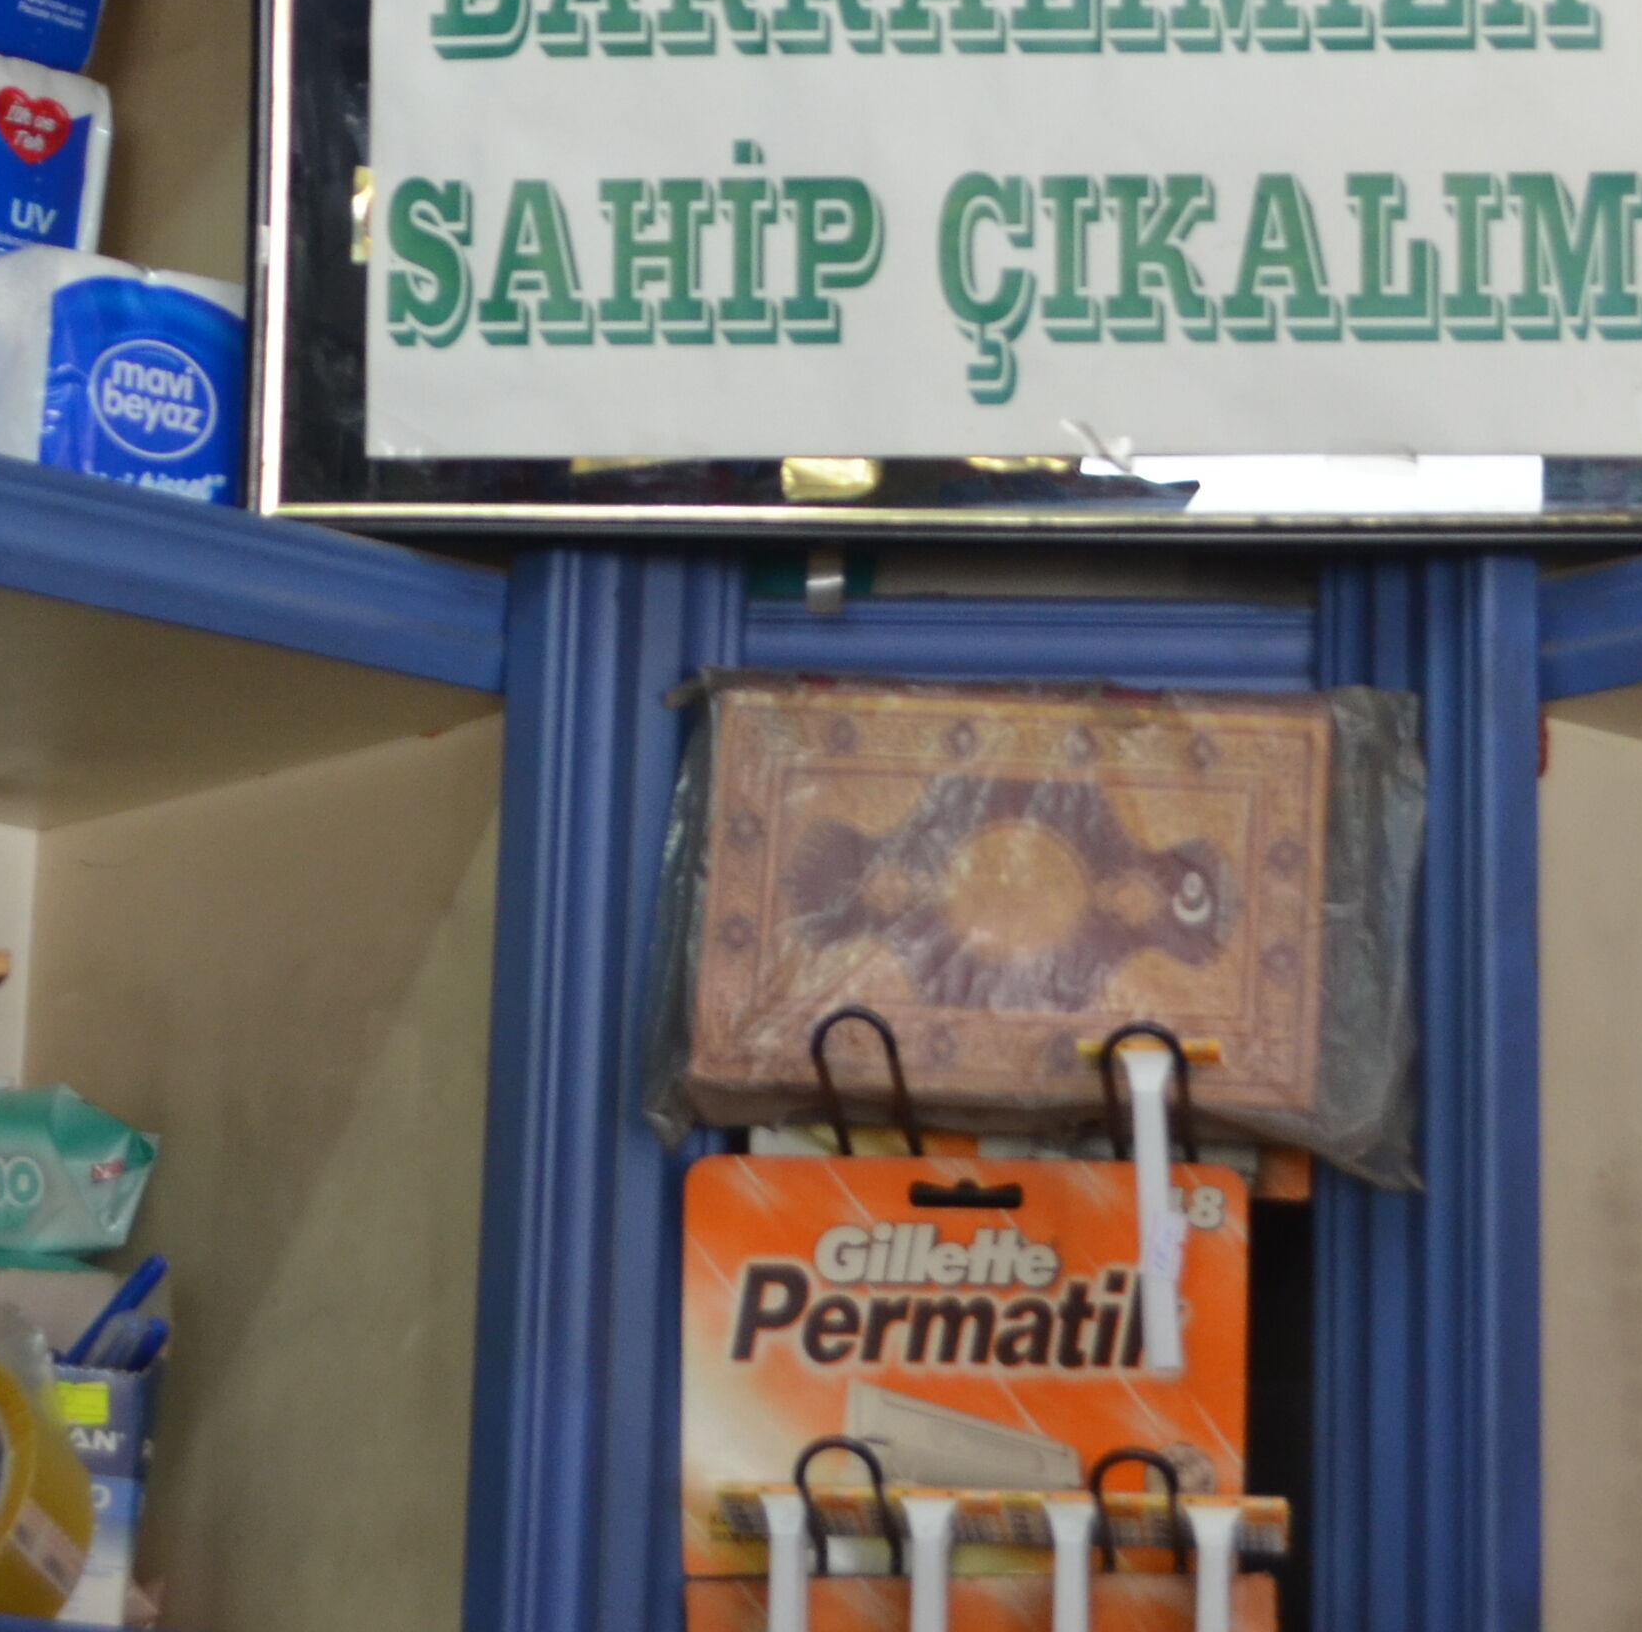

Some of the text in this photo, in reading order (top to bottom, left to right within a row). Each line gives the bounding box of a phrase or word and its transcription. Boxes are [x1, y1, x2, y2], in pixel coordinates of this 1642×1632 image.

[9, 197, 58, 237] UV
[386, 139, 884, 348] SAHİP
[102, 376, 204, 438] beyaz
[110, 355, 196, 404] mavi
[815, 1222, 1061, 1288] Gillette
